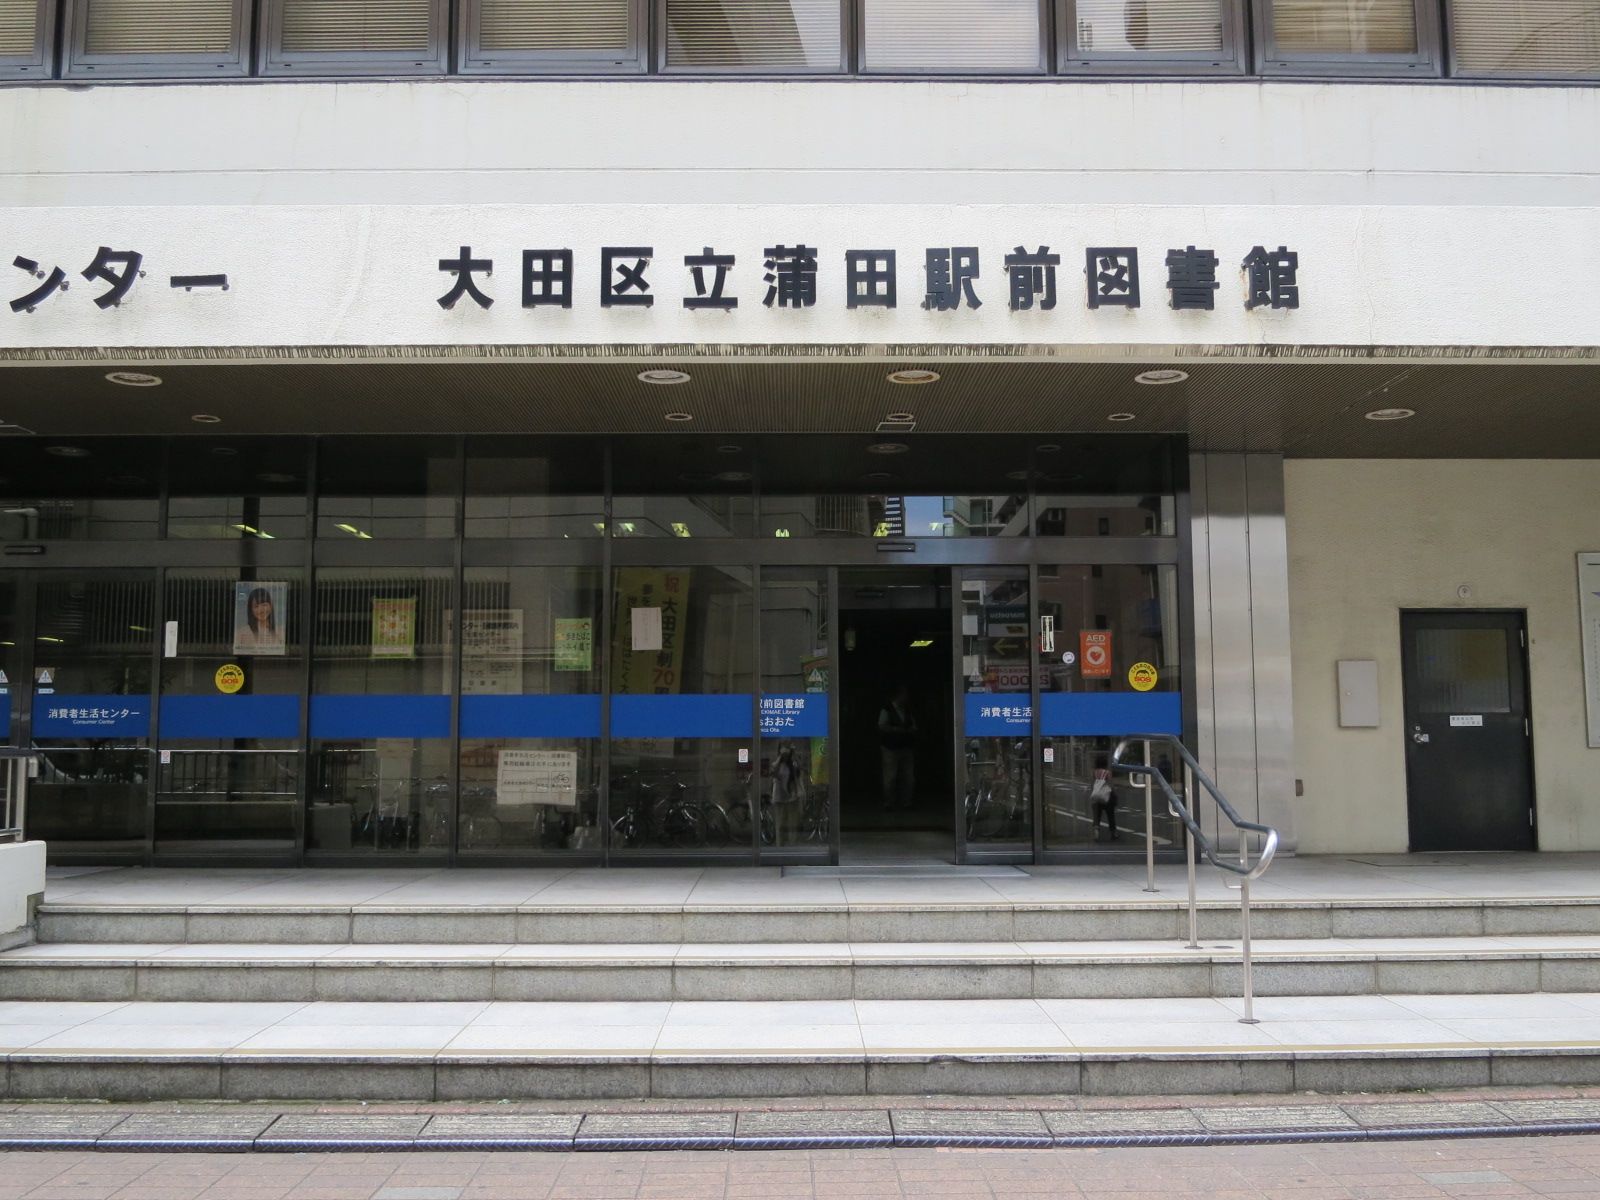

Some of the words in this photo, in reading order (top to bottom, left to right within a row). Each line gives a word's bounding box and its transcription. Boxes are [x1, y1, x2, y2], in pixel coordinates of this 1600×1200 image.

[9, 246, 227, 312] ンター
[436, 244, 1300, 310] 大田区立蒲田駅前図書館
[48, 708, 140, 719] 消費者生活センター
